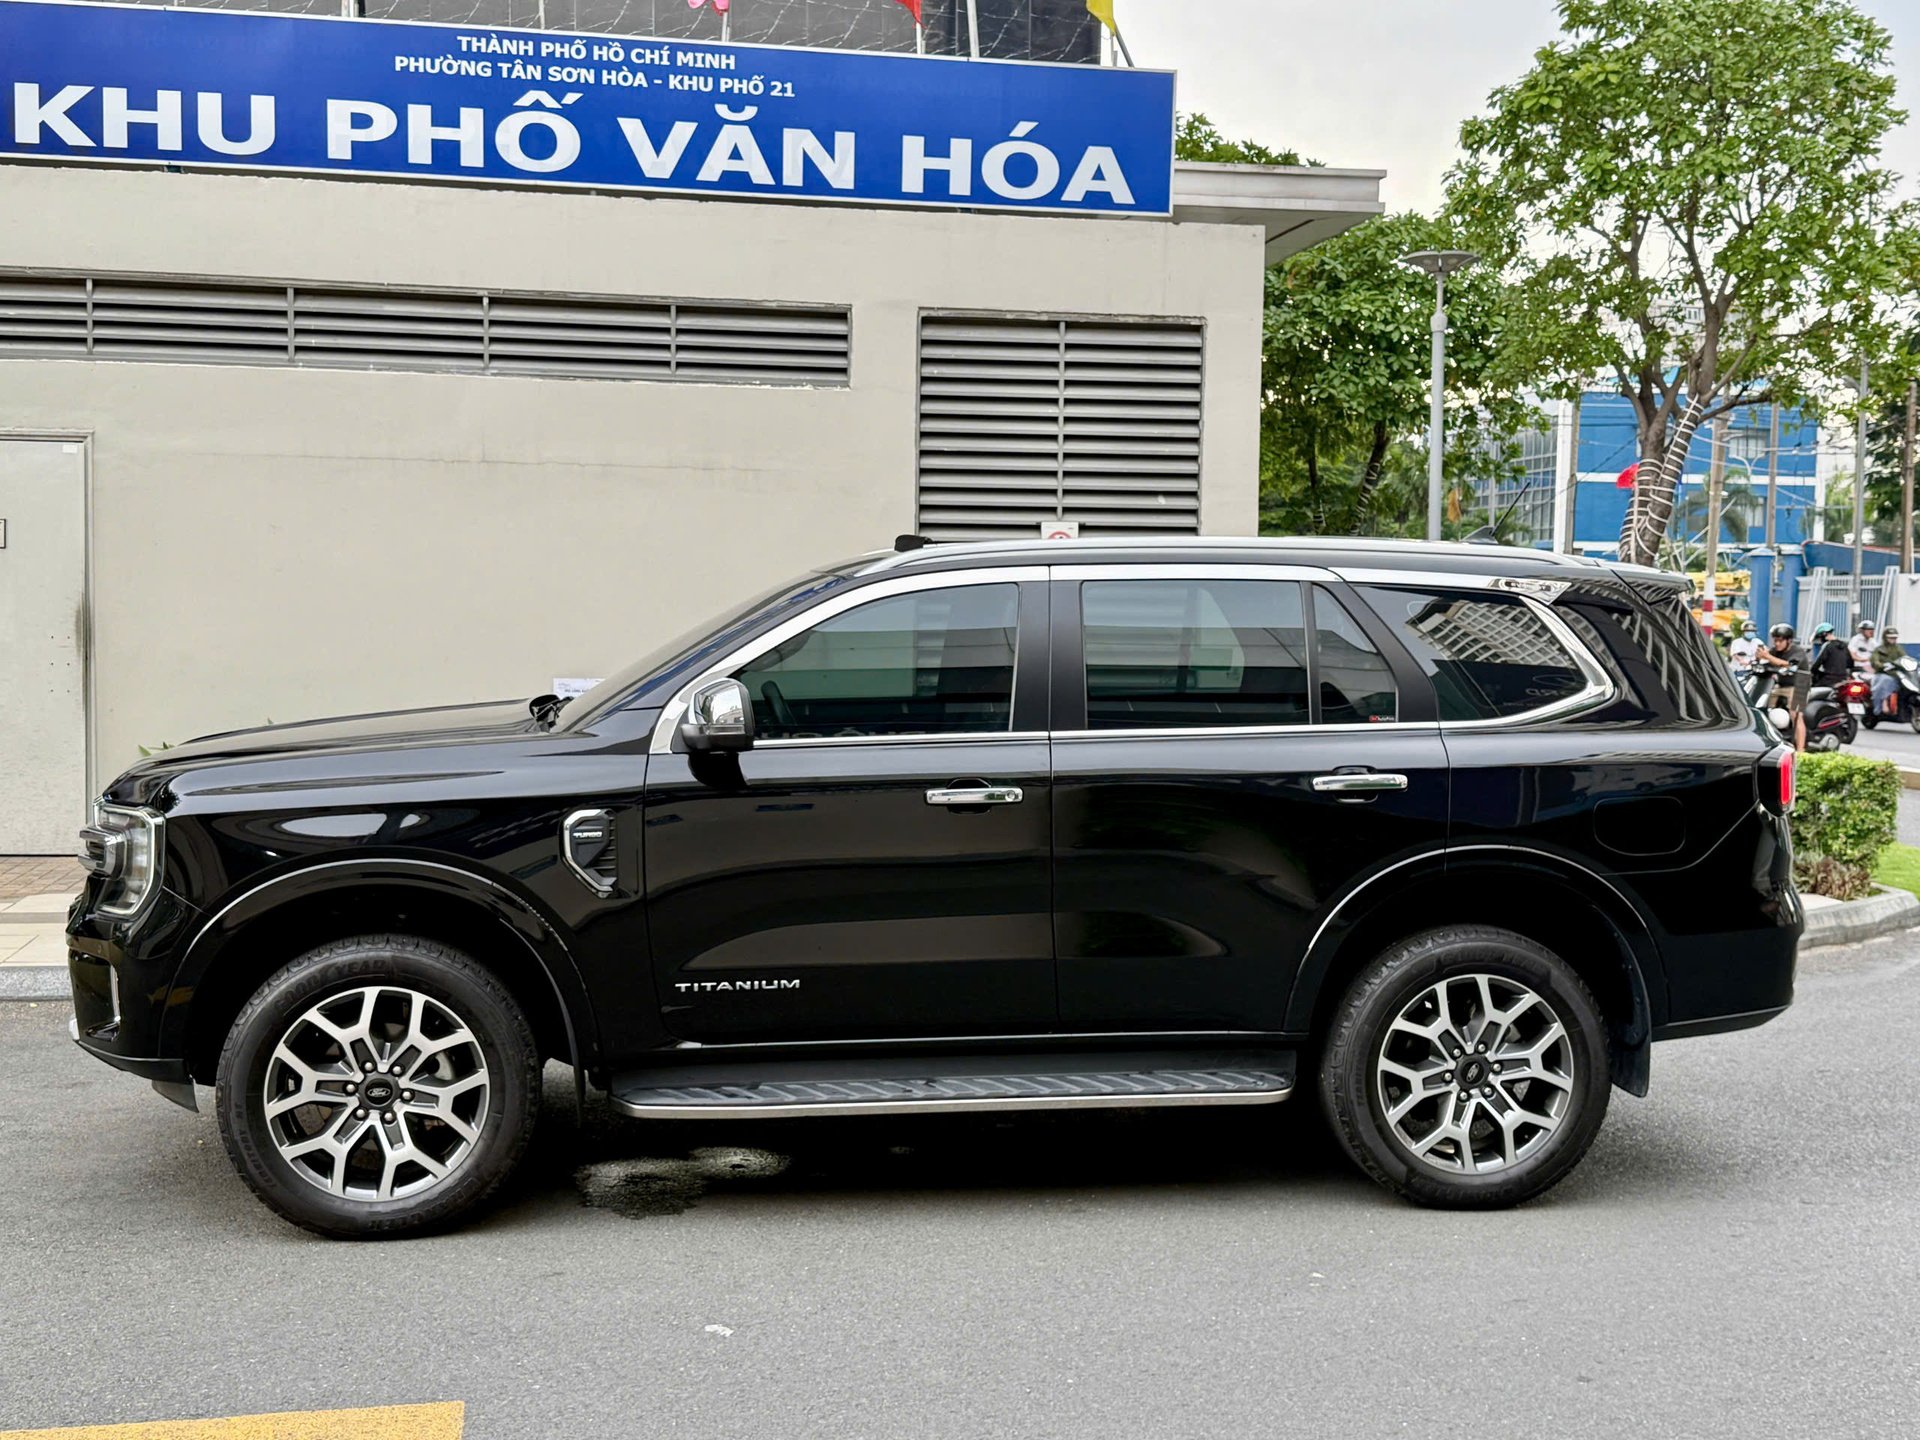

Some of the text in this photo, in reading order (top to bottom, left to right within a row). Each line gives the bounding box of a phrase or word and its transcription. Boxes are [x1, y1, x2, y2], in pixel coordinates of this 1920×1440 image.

[456, 33, 736, 70] THÀNH PHỐ HỒ CHÍ MINH
[395, 54, 492, 77] PHƯỜNG
[497, 59, 542, 80] TÂN
[548, 66, 596, 84] SƠN
[602, 66, 649, 88] HÒA
[668, 74, 714, 92] KHU
[719, 75, 765, 96] PHỐ
[770, 81, 795, 98] 21
[13, 82, 1136, 204] KHU PHỐ VĂN HÓA
[674, 979, 800, 992] TITANIUM
